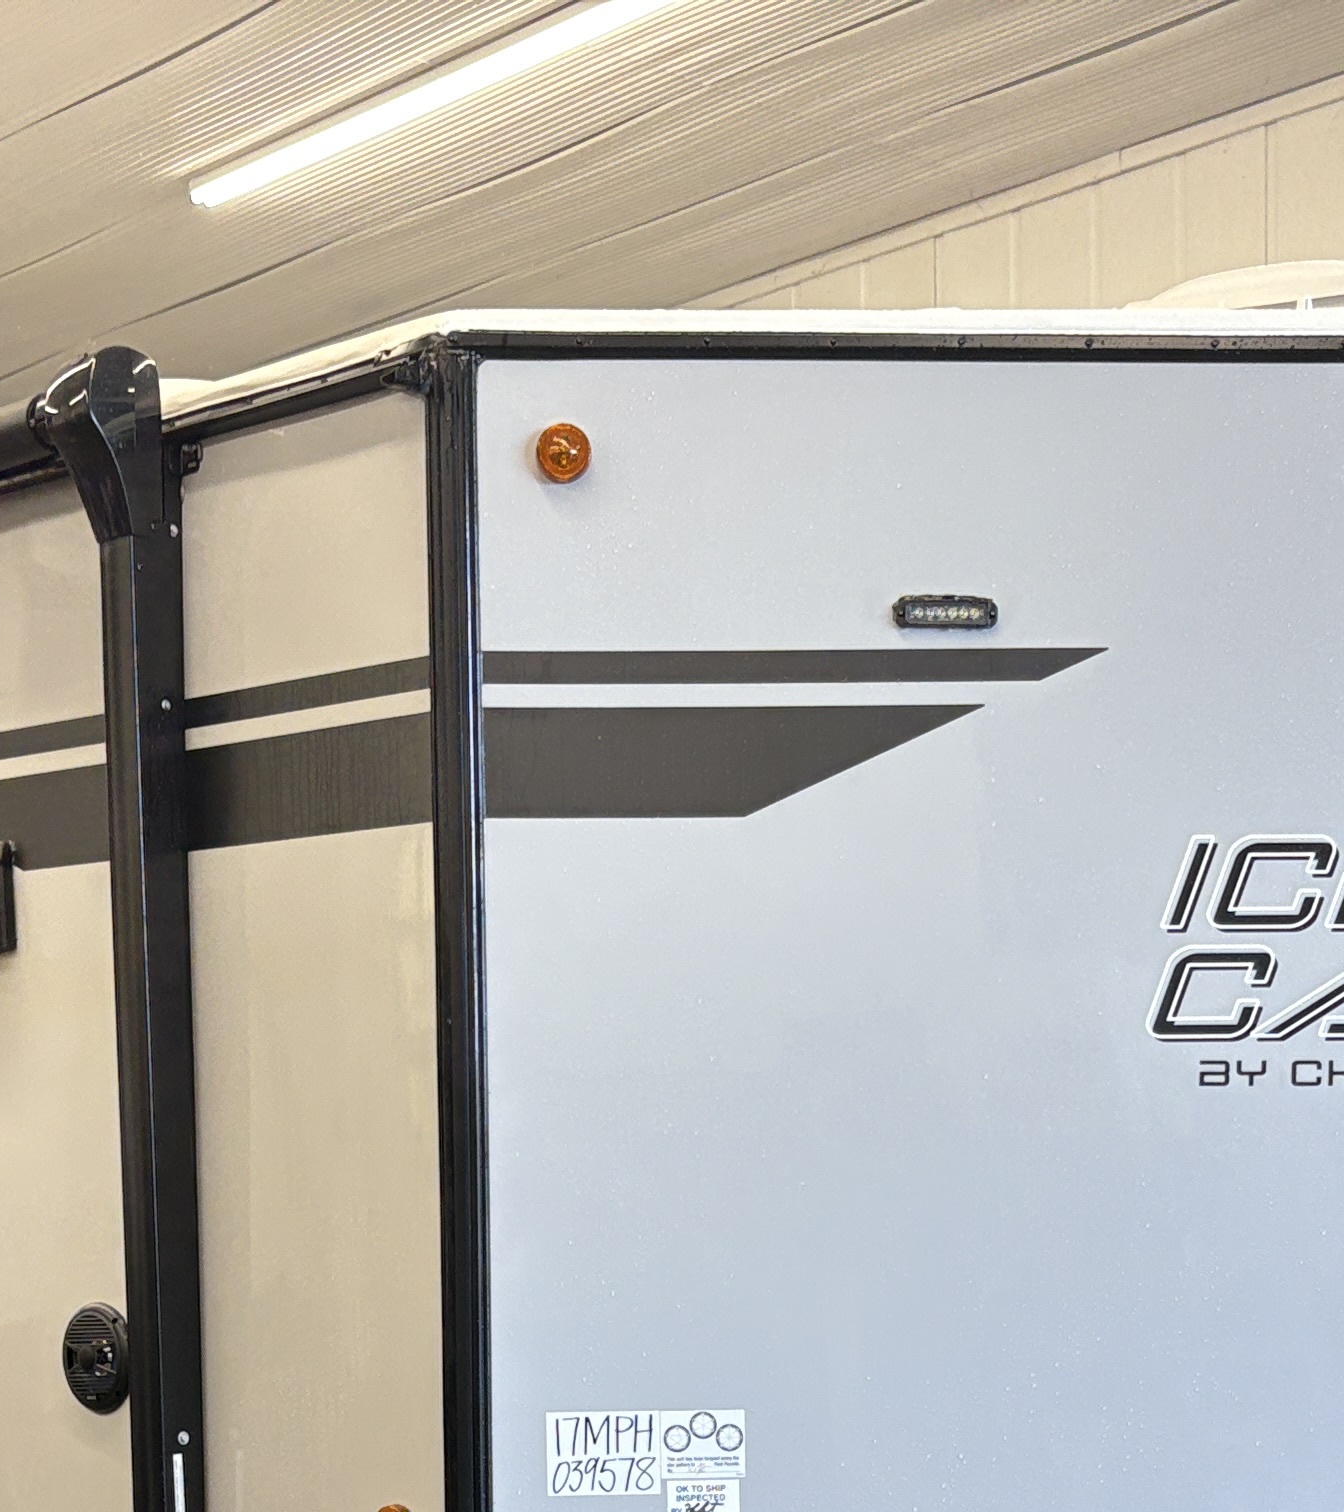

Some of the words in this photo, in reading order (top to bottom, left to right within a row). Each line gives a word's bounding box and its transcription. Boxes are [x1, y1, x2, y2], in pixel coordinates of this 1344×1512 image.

[1198, 1059, 1268, 1087] BY
[555, 1414, 654, 1456] 17MPH
[552, 1457, 657, 1494] 039578
[676, 1485, 689, 1493] OK
[691, 1485, 704, 1493] TO
[706, 1484, 726, 1492] SHIP
[676, 1494, 726, 1502] INSPECTED
